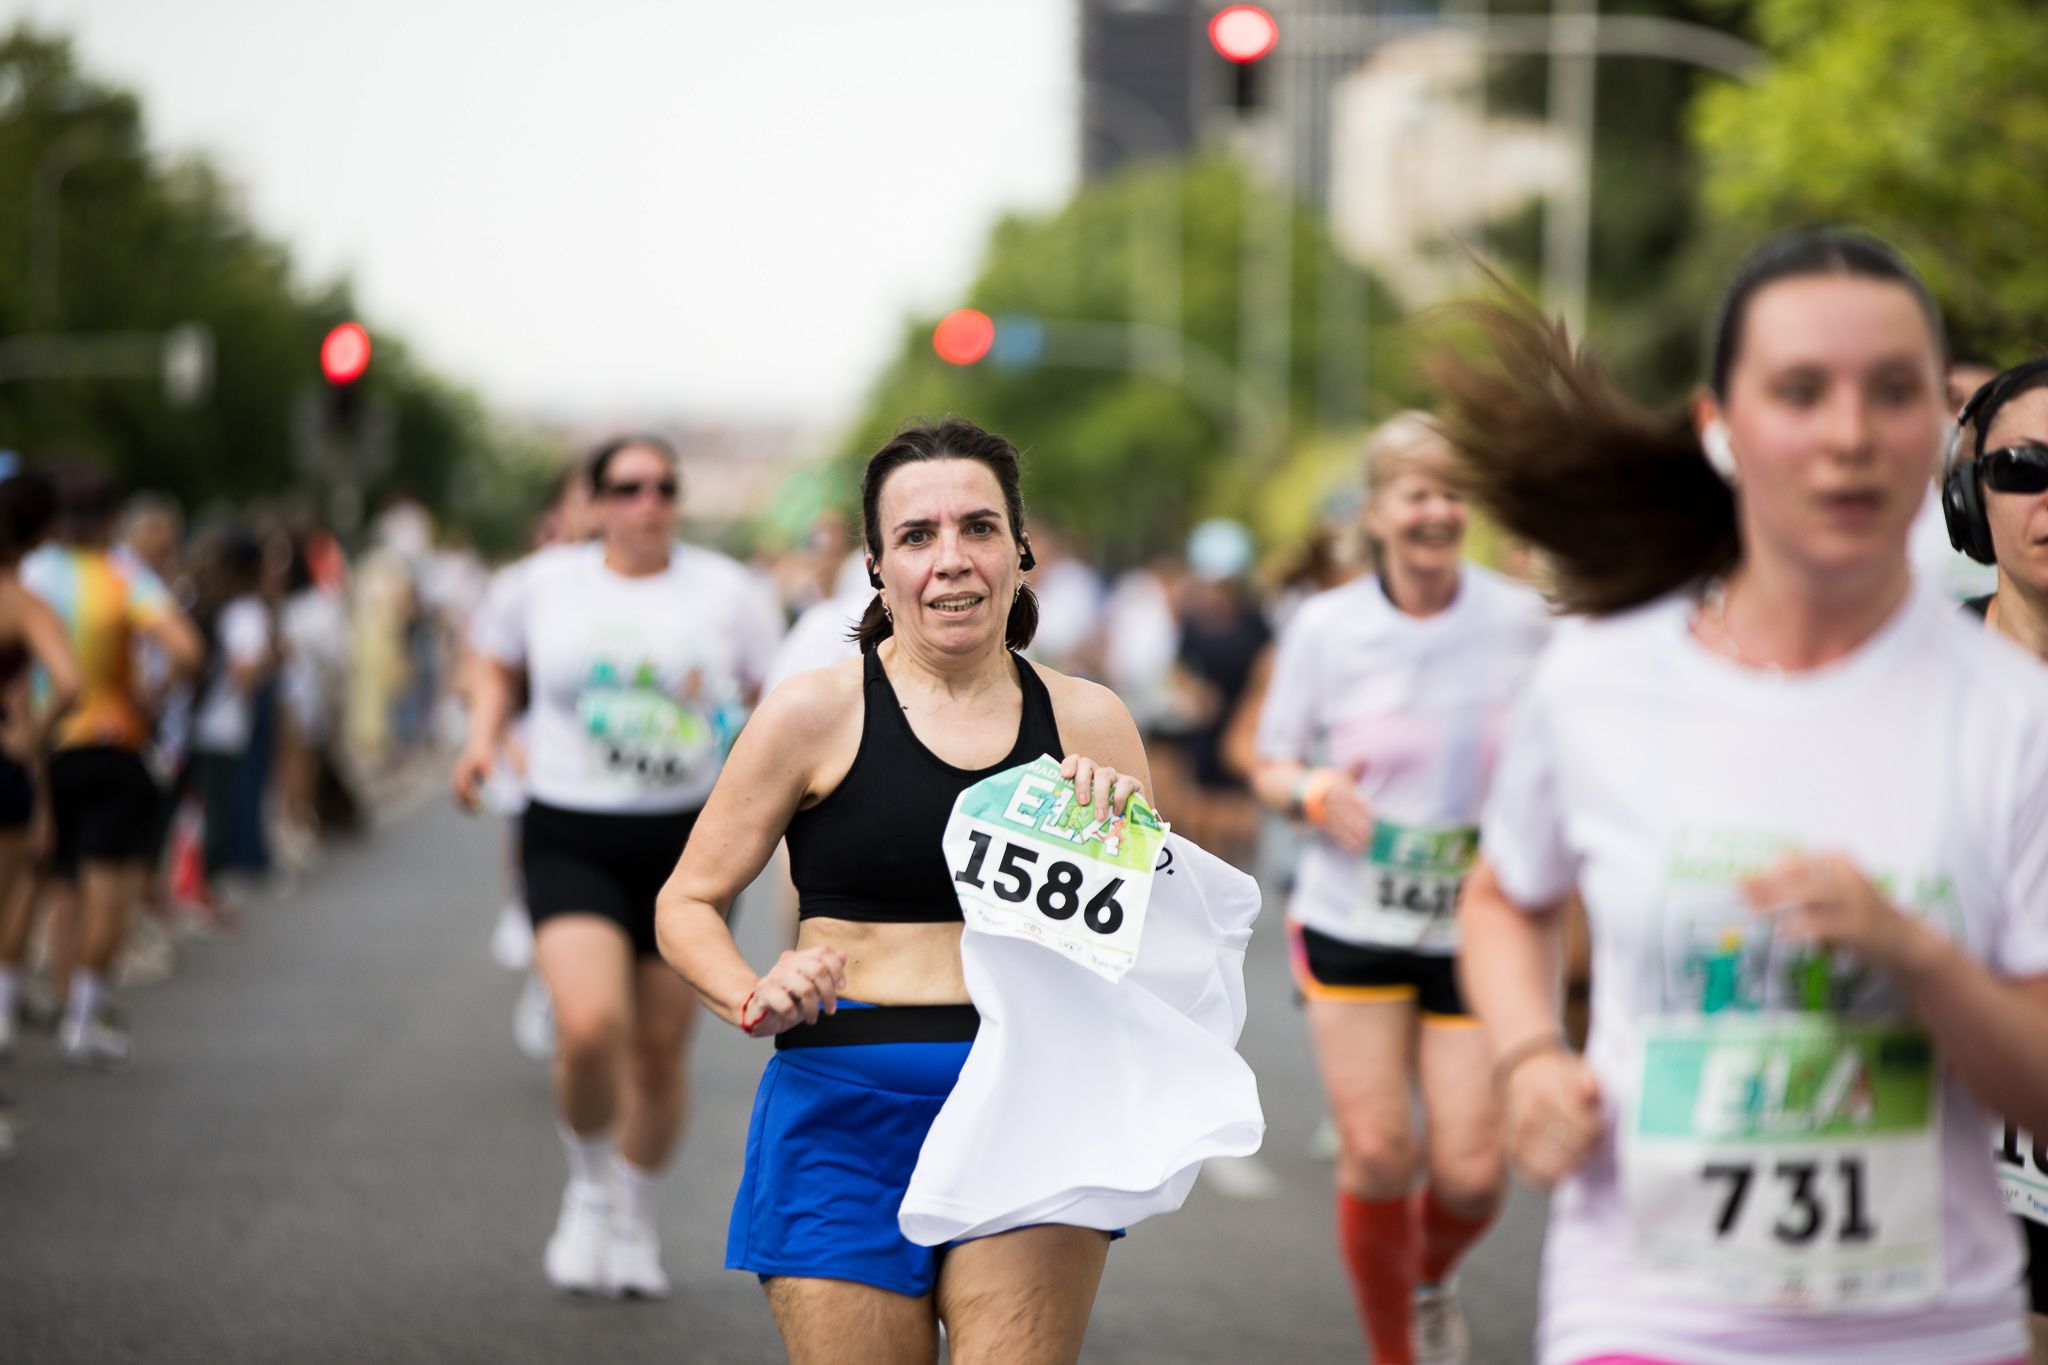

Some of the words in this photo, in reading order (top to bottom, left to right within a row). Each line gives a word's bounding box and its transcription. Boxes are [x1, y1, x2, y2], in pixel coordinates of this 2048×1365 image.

[955, 829, 1126, 935] 1586
[1691, 1042, 1877, 1136] ELA
[1699, 1153, 1879, 1247] 731
